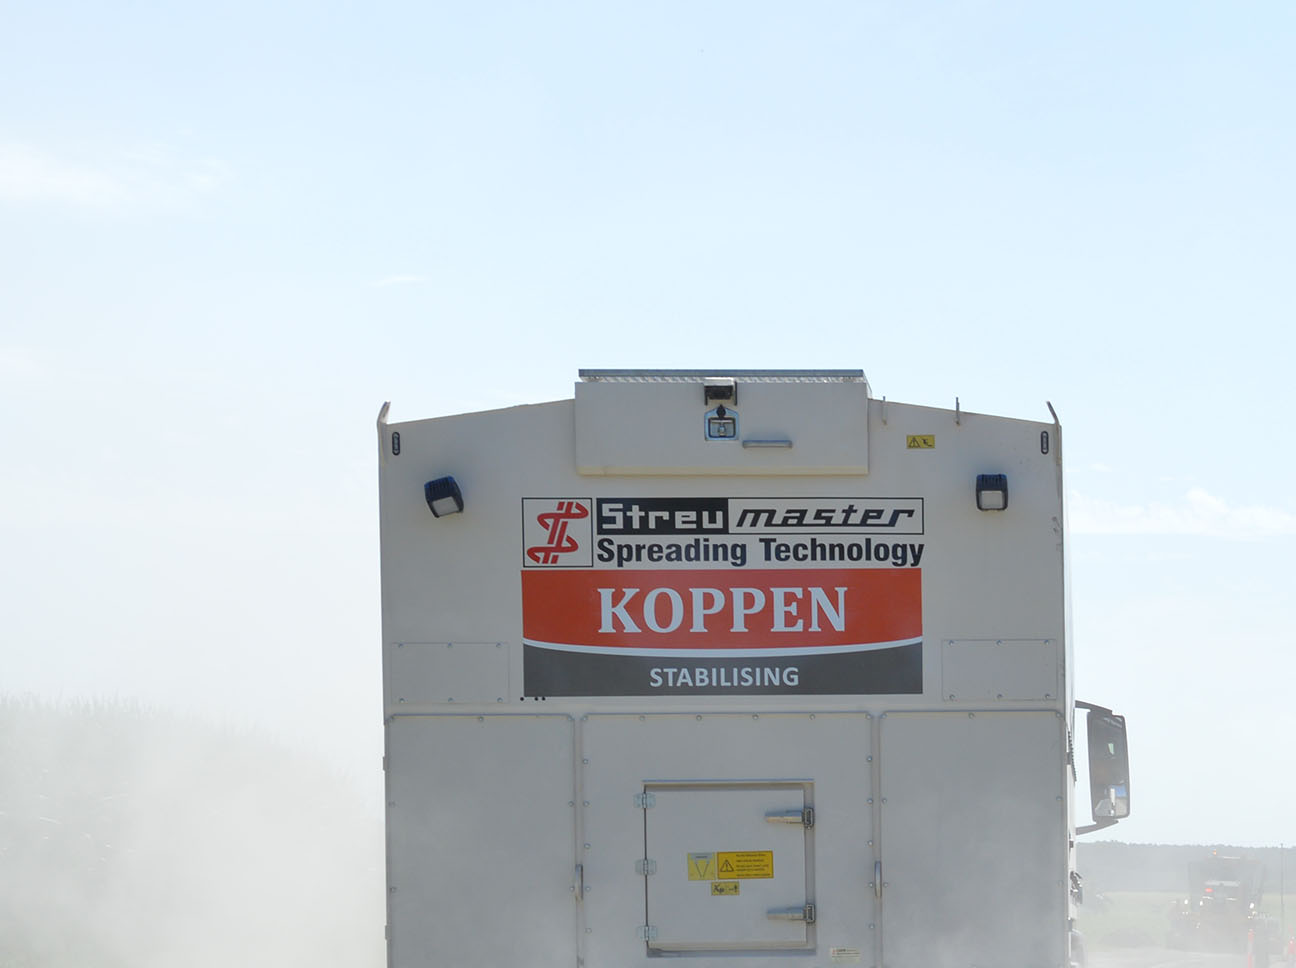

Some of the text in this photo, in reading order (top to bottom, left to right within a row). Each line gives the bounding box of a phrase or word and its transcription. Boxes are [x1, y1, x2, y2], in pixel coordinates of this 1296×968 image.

[597, 538, 925, 567] Spreading Technology
[597, 587, 848, 633] KOPPEN
[649, 667, 800, 688] STABILISING
